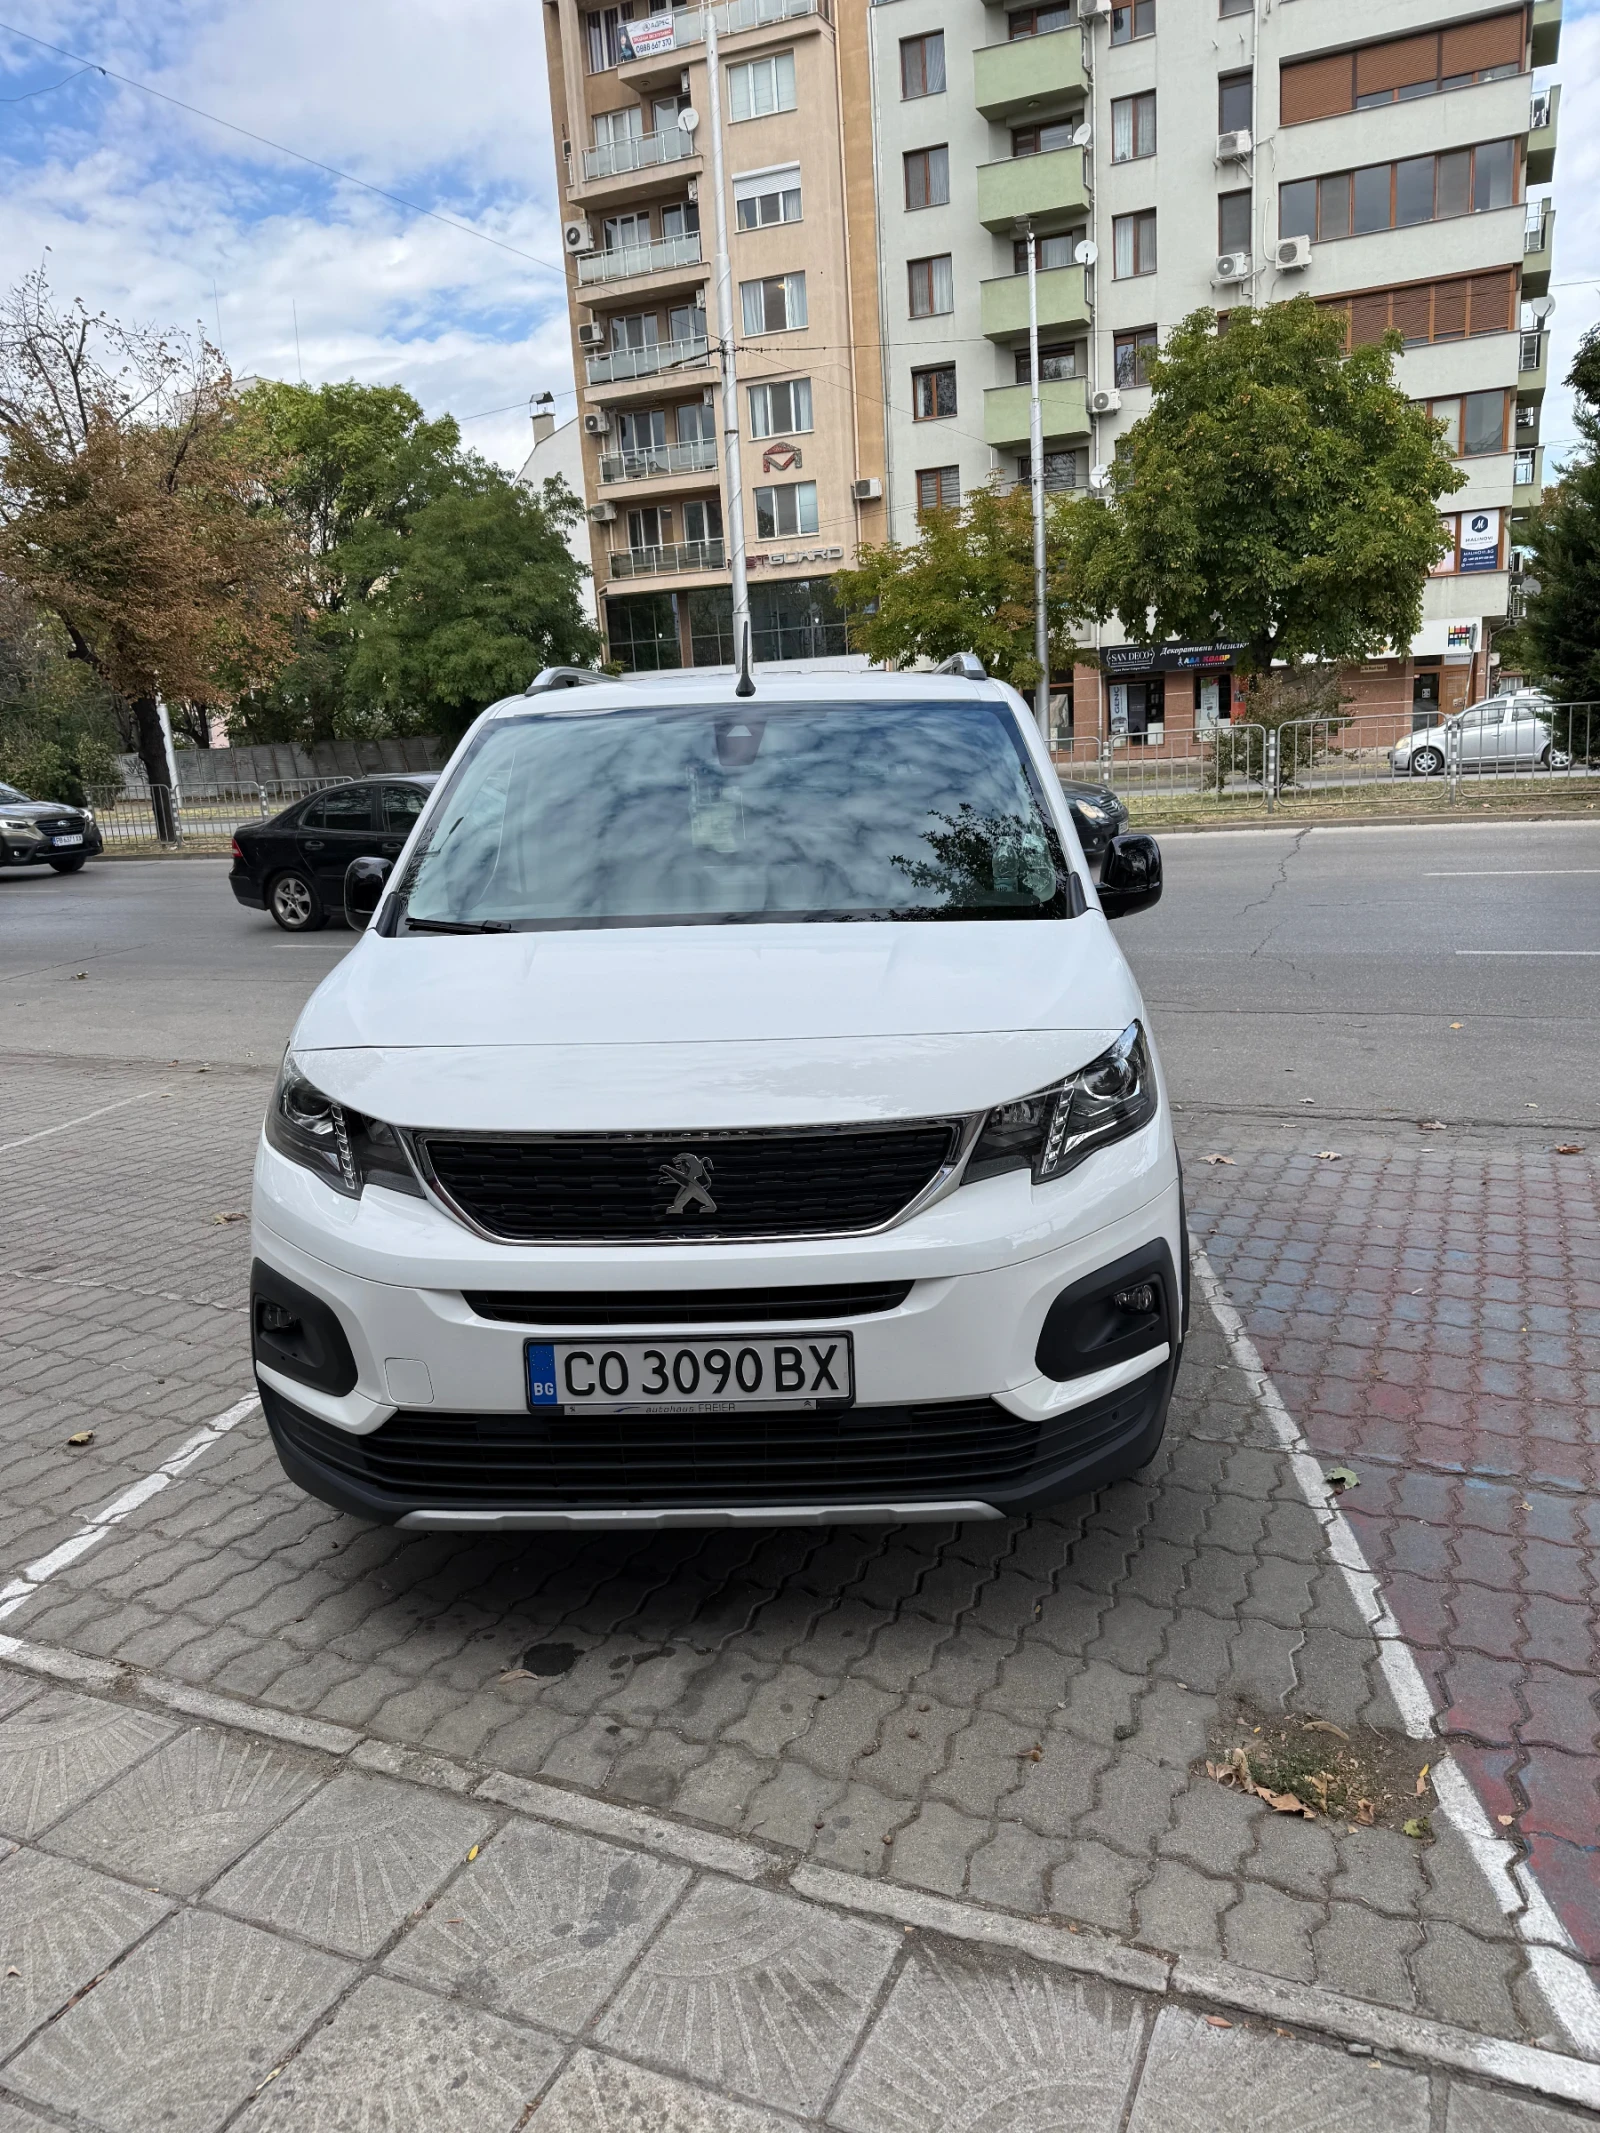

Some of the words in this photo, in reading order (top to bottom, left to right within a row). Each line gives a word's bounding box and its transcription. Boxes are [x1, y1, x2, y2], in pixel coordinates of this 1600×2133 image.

[727, 546, 844, 571] ETGUARD
[1159, 644, 1213, 656] Декоративни
[1111, 652, 1127, 662] SAN
[1128, 651, 1150, 661] DECO
[564, 1350, 630, 1397] CO
[641, 1347, 764, 1395] 3090
[773, 1344, 840, 1393] BX
[533, 1383, 554, 1396] BG
[645, 1405, 694, 1413] autohaus
